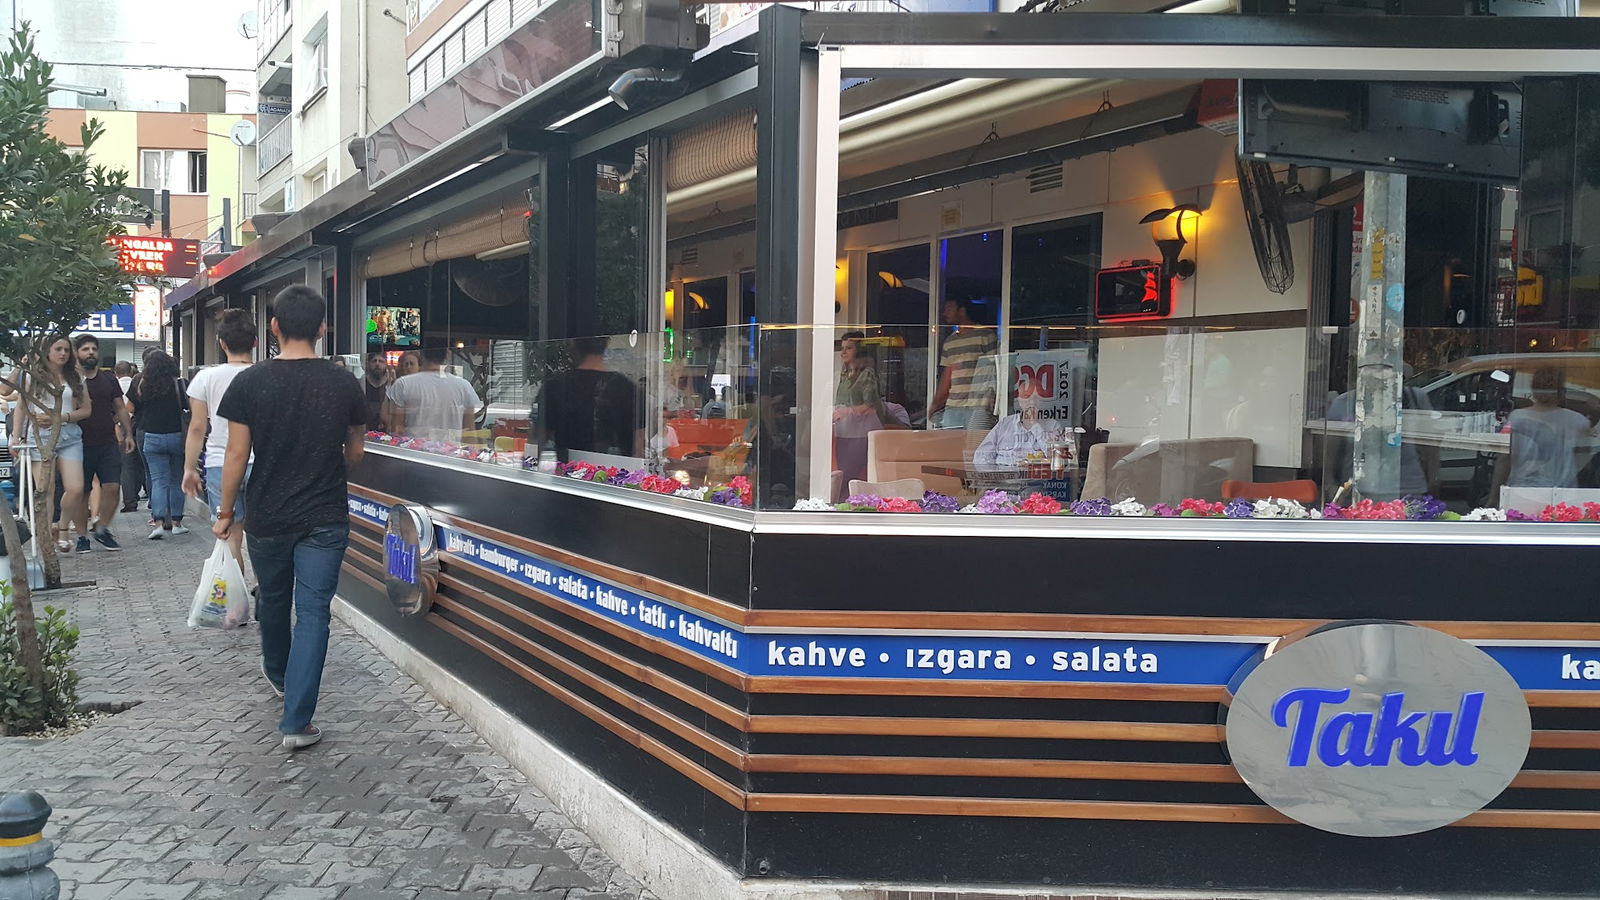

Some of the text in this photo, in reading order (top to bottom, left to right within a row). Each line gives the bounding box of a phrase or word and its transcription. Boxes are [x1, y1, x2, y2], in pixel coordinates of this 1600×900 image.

[449, 532, 738, 659] kahvaltı hamburger ızgara salata kahve tatlı kahvaltı
[768, 639, 1158, 675] kahve ızgara salata
